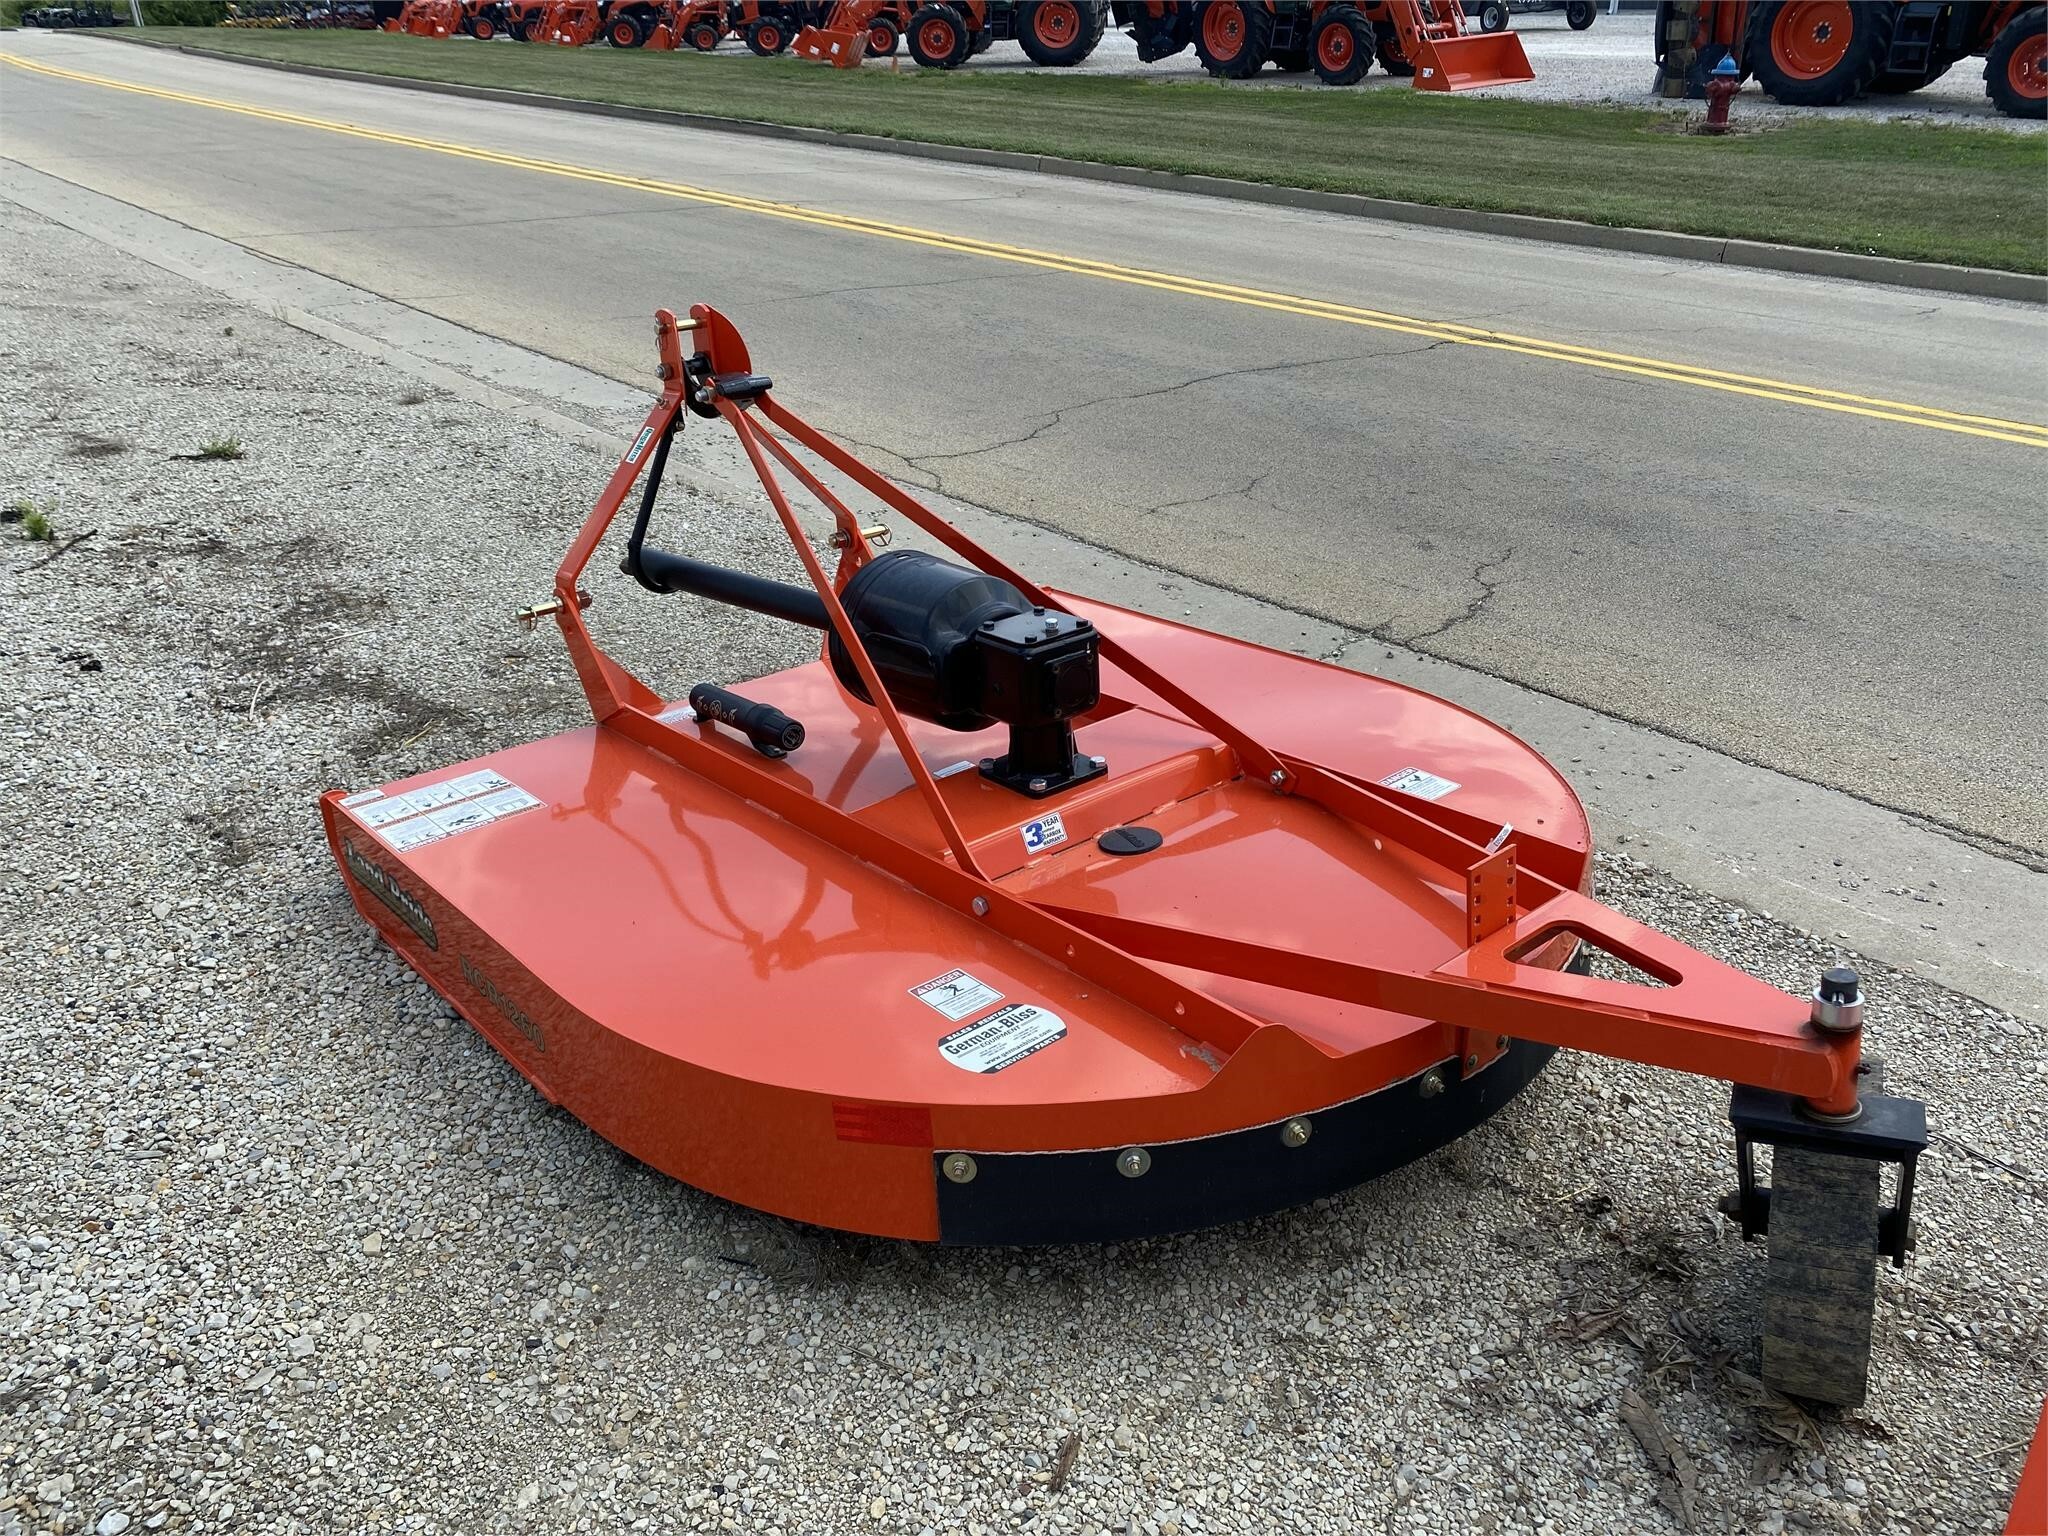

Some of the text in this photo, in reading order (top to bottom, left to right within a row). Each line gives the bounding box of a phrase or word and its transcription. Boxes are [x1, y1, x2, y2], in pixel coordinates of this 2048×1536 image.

[1042, 815, 1059, 828] YEAR
[1026, 822, 1044, 847] 3
[1043, 834, 1065, 846] WARRANTY
[924, 970, 962, 991] DANGER
[944, 1007, 1038, 1055] German-Bliss
[946, 1006, 1013, 1041] SALES RENTALS
[979, 1025, 1020, 1048] EQUIPMENT
[994, 1034, 1061, 1070] SERVICE PARTS
